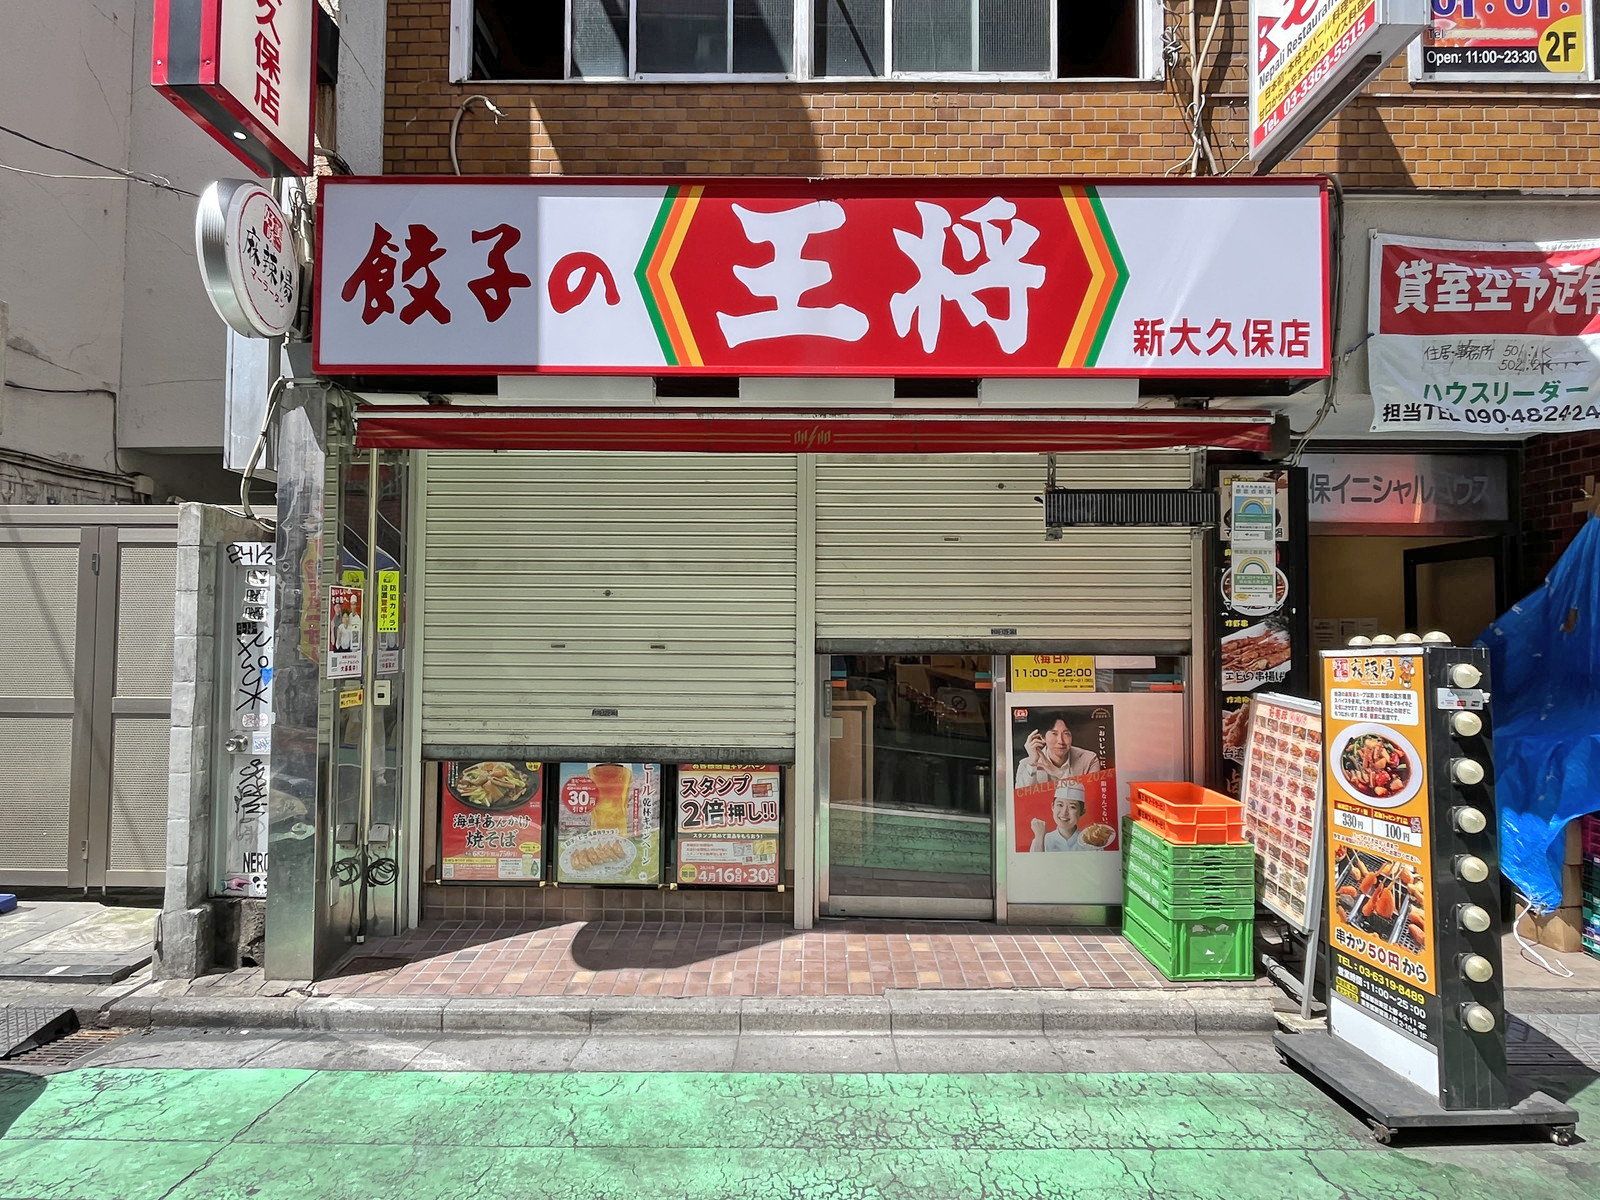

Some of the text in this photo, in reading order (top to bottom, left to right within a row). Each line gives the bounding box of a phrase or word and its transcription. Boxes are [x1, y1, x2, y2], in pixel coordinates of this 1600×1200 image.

[1260, 48, 1286, 90] Nepali
[1286, 0, 1338, 57] Restauran
[1427, 50, 1537, 66] Open: 11:00~23:30
[1546, 31, 1577, 62] 2F
[254, 0, 281, 126] 久保店
[1284, 15, 1366, 116] 03-3363-5515
[341, 195, 1047, 356] 餃子の 王将
[1133, 318, 1311, 358] 新大久保店
[1423, 380, 1590, 405] ハウスリーダー
[1383, 403, 1461, 422] 担当TEL
[1225, 670, 1286, 682] エビの串揚げ
[681, 775, 751, 796] スタンプ
[1016, 771, 1113, 798] CHALLENGE 2024
[453, 813, 531, 829] 海鮮あんかけ
[681, 800, 777, 828] 2倍押し!!
[1342, 813, 1364, 830] 330円
[1385, 824, 1410, 842] 100円
[465, 830, 519, 848] 焼そば
